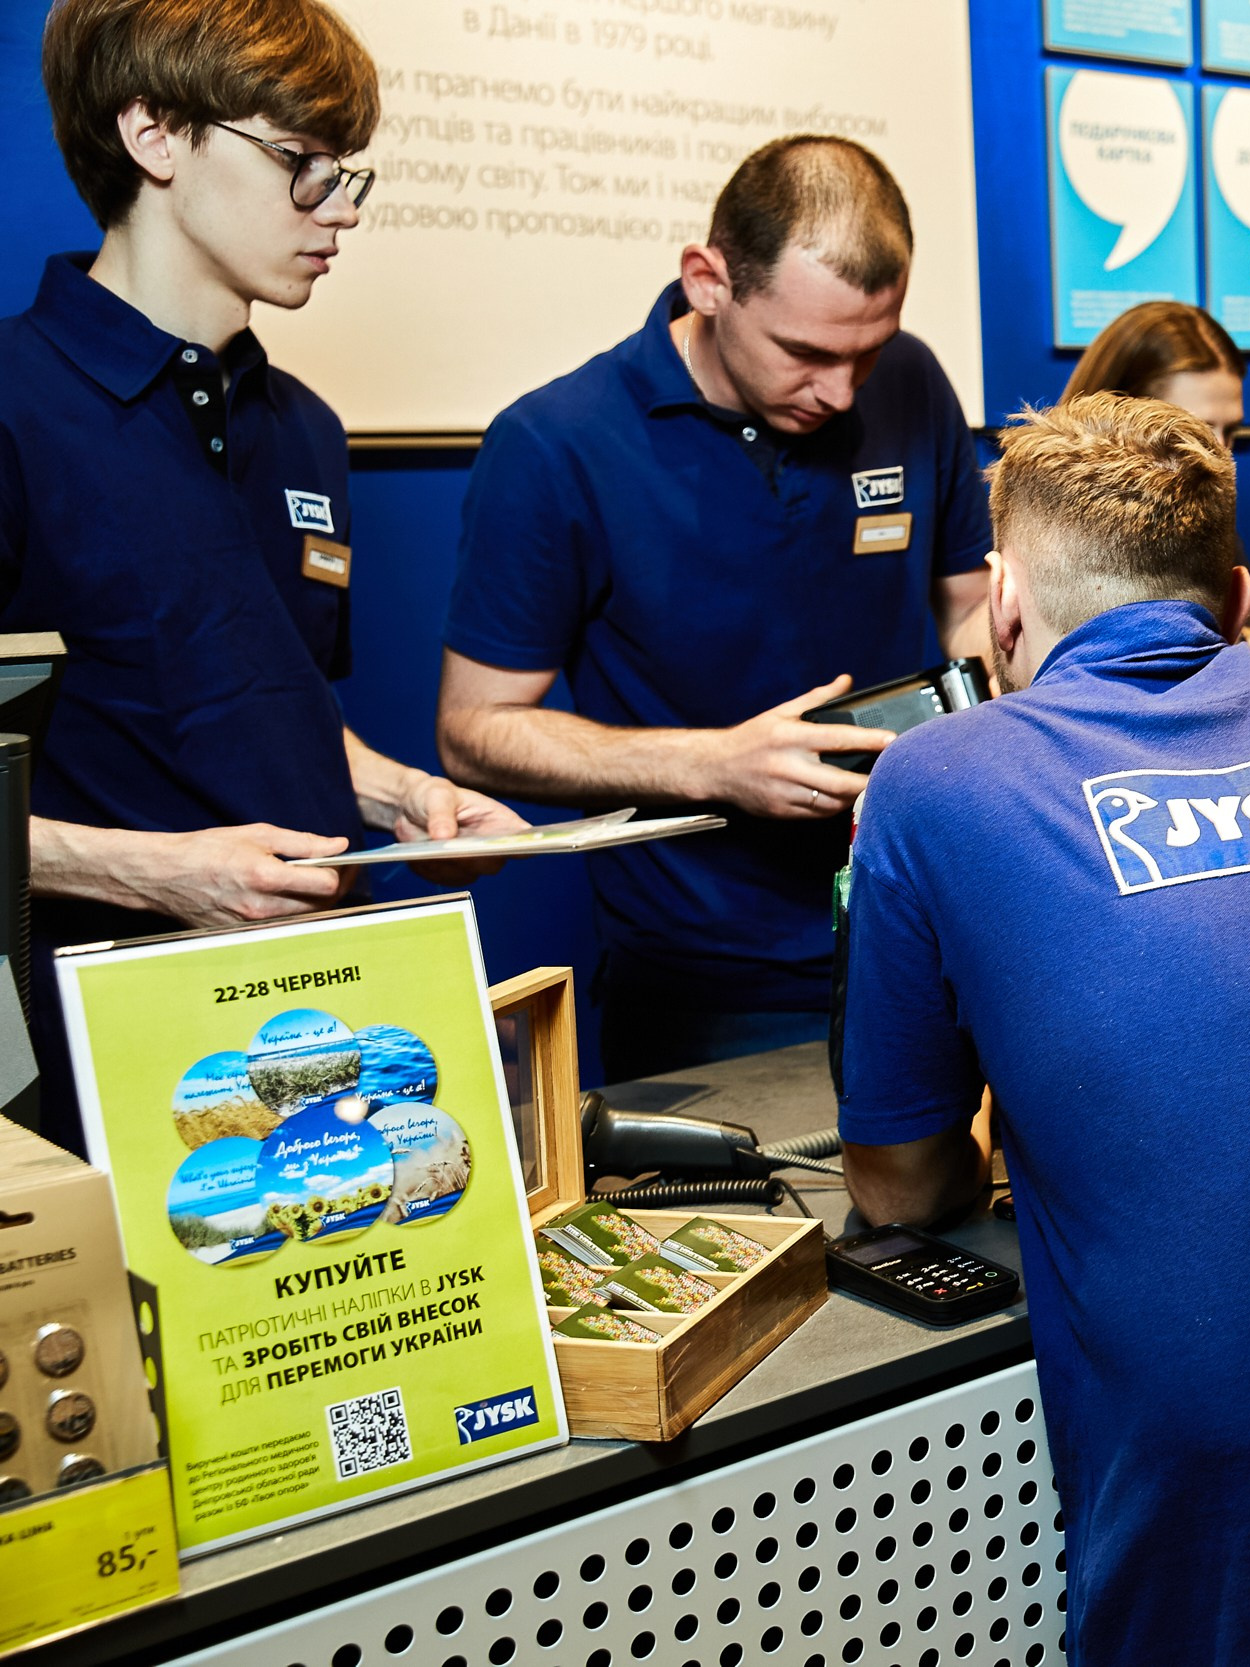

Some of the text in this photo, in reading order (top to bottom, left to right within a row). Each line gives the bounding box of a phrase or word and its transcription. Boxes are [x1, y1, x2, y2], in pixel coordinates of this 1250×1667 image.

[462, 8, 481, 34] в
[488, 4, 557, 41] Данії
[564, 20, 582, 45] в
[592, 18, 648, 52] 1979
[729, 2, 839, 43] магазину
[413, 70, 556, 106] прагнемо
[561, 77, 625, 117] бути
[631, 89, 776, 127] найкращим
[781, 101, 888, 136] вибором
[380, 111, 476, 146] купців
[484, 119, 513, 146] та
[520, 122, 676, 160] працівників
[555, 163, 607, 195] Тож
[613, 176, 650, 198] ми
[485, 206, 663, 245] пропозицією
[214, 965, 361, 1003] 22-28 ЧЕРВНЯ!
[325, 1213, 346, 1224] JYSK
[274, 1249, 406, 1299] КУПУЙТЕ
[199, 1266, 485, 1352] ПАТРІОТИЧНІ НАЛІПКИ В JYSK
[212, 1293, 481, 1376] ТА ЗРОБІТЬ СВІЙ ВНЕСОК
[221, 1318, 483, 1407] ДЛЯ ПЕРЕМОГИ УКРАЇНИ
[473, 1395, 535, 1431] JYSK
[261, 1430, 311, 1450] передаємо
[270, 1440, 319, 1459] медичного
[97, 1544, 158, 1578] 85,-
